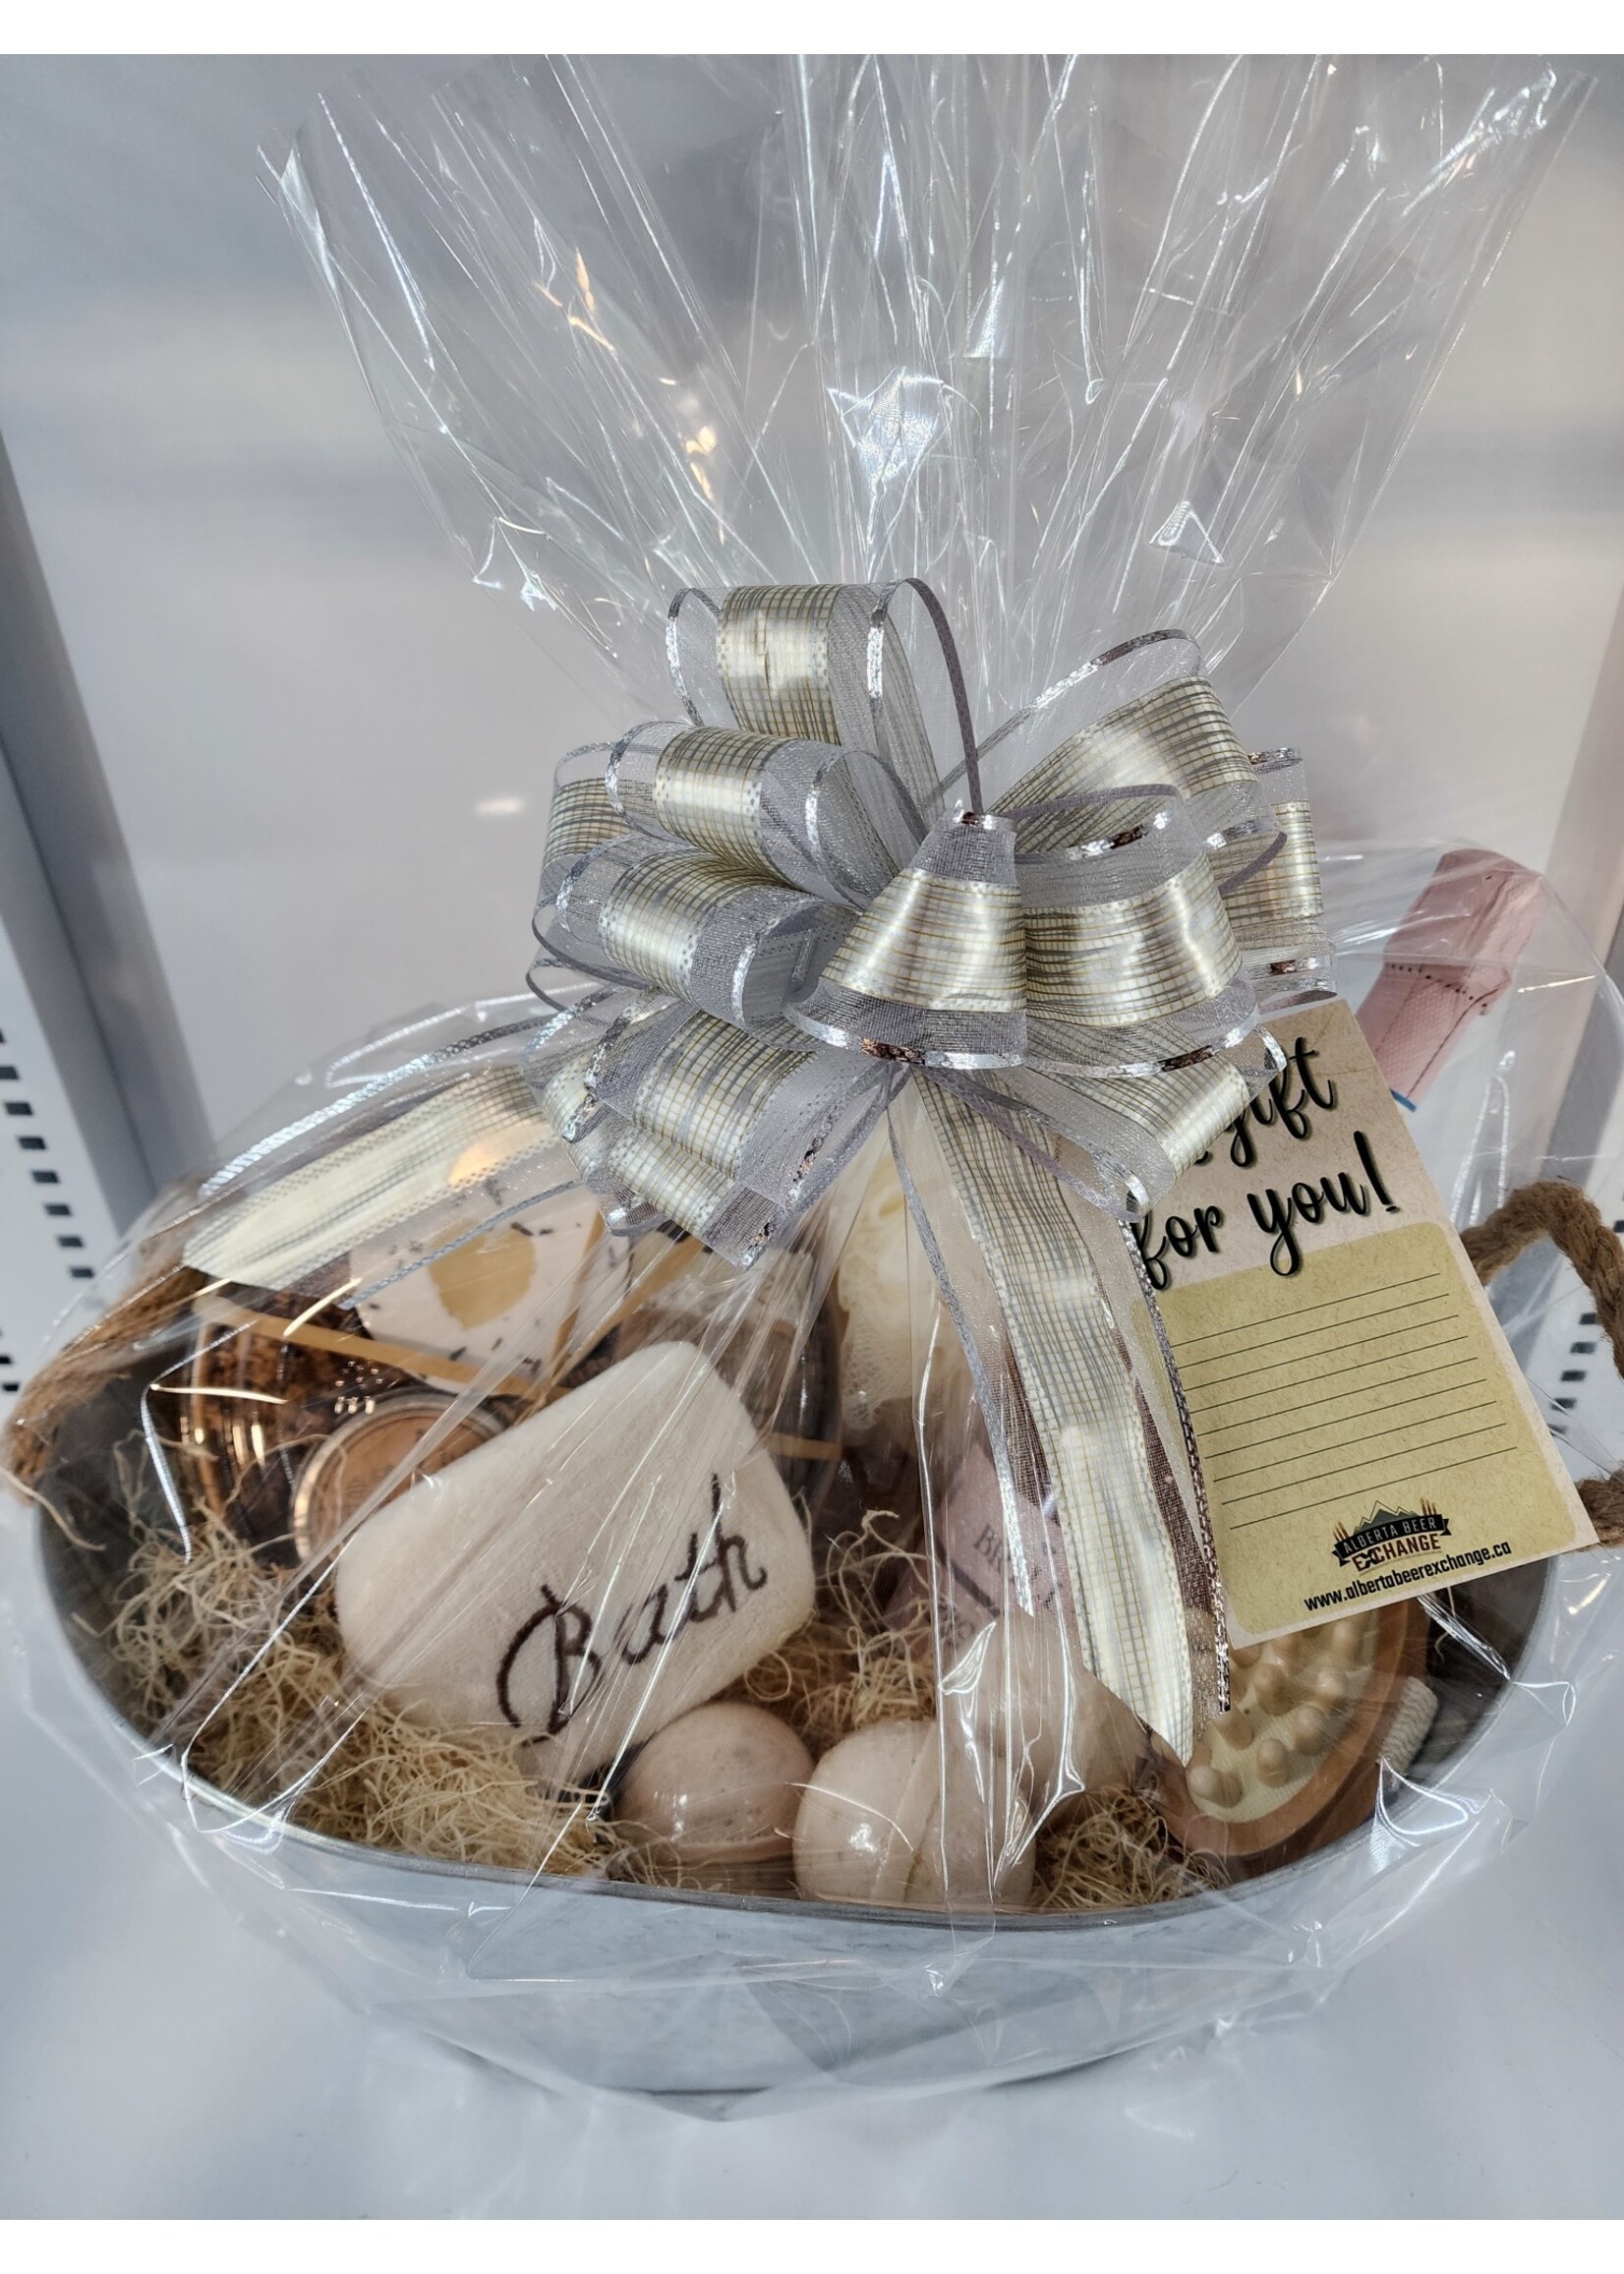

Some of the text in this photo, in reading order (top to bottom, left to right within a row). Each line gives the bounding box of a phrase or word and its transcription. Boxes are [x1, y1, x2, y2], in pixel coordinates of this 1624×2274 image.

[1126, 1130, 1400, 1291] for you!
[1343, 1516, 1438, 1555] ALBERTA BEER
[1351, 1532, 1442, 1573] EXCHANGE
[495, 1473, 769, 1749] Bath
[1304, 1541, 1513, 1612] www.albertabeerexchange.ca
